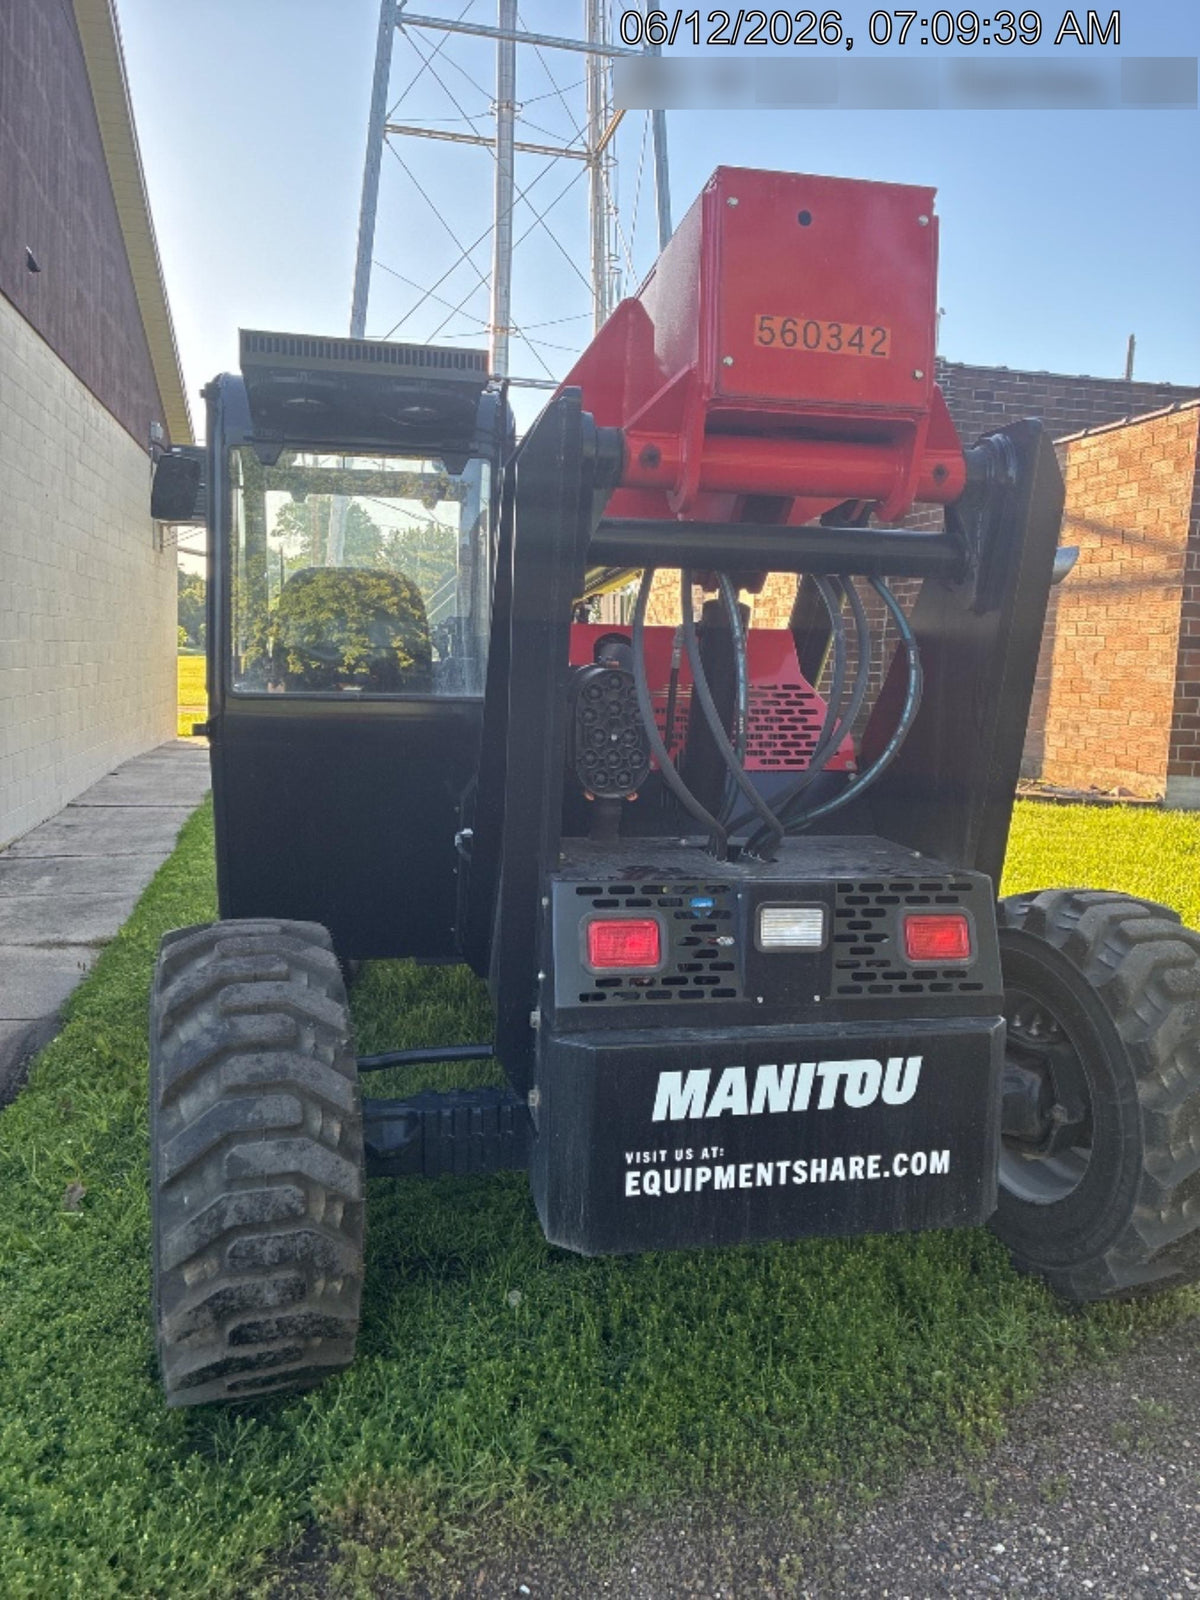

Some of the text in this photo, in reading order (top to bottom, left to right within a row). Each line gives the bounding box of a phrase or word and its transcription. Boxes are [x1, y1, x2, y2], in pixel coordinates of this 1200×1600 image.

[757, 315, 887, 356] 560342
[652, 1056, 923, 1121] MANITOU
[624, 1149, 951, 1197] EQUIPMENTSHARE.COM
[625, 1146, 725, 1164] VISIT US AT:
